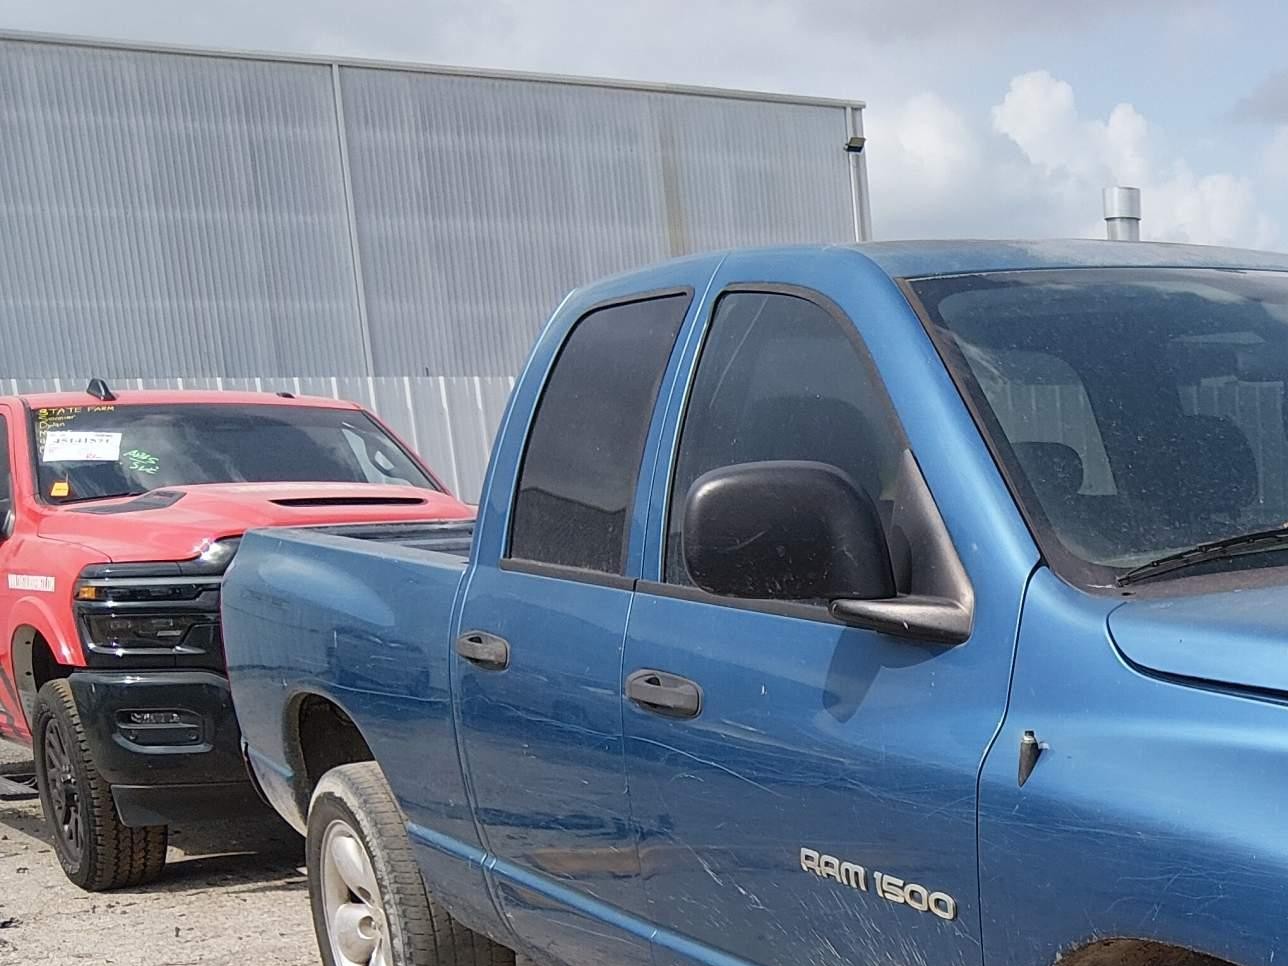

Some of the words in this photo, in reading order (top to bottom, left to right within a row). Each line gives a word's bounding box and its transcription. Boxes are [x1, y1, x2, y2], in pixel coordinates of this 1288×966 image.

[39, 407, 81, 416] STATE
[801, 847, 867, 892] RAM
[873, 871, 956, 920] 1500
